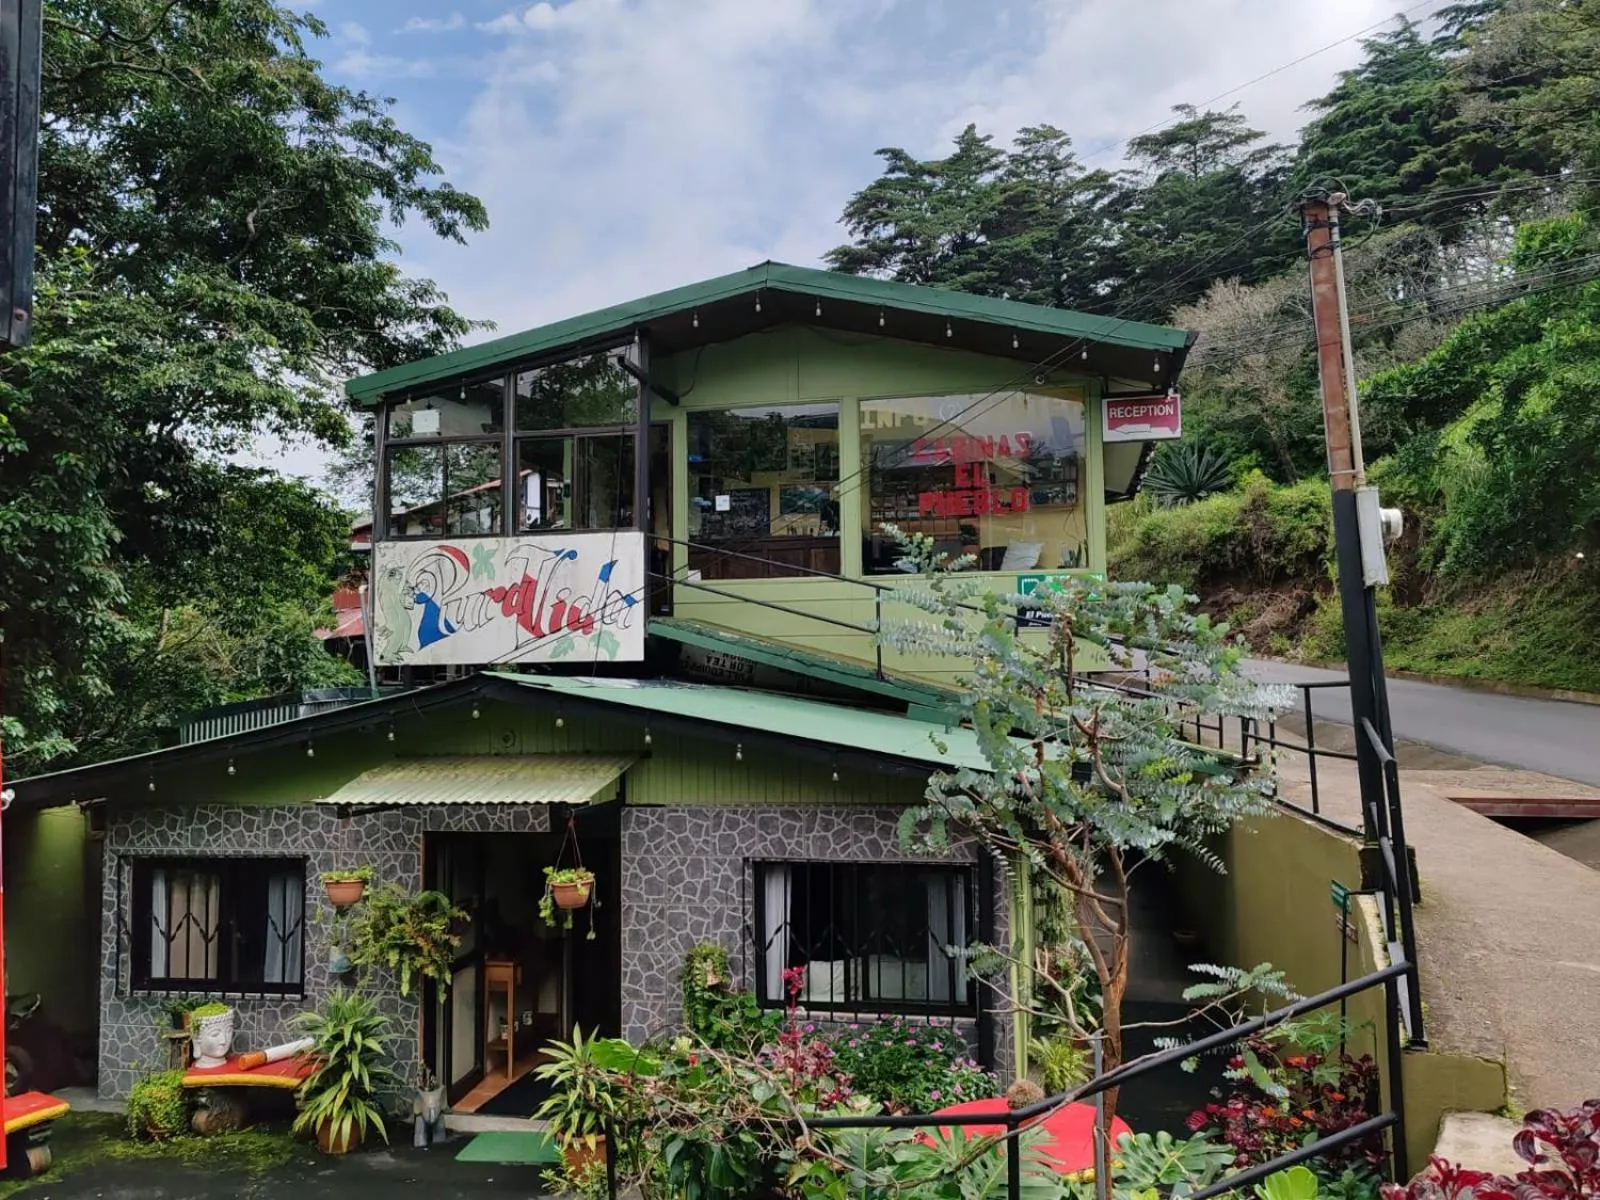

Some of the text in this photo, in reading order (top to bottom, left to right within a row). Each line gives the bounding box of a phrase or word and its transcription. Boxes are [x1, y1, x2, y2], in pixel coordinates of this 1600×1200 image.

[1108, 404, 1174, 419] RECEPTION
[955, 462, 985, 488] EL
[918, 488, 1030, 516] PUEBLO
[407, 544, 638, 651] Pura Vida
